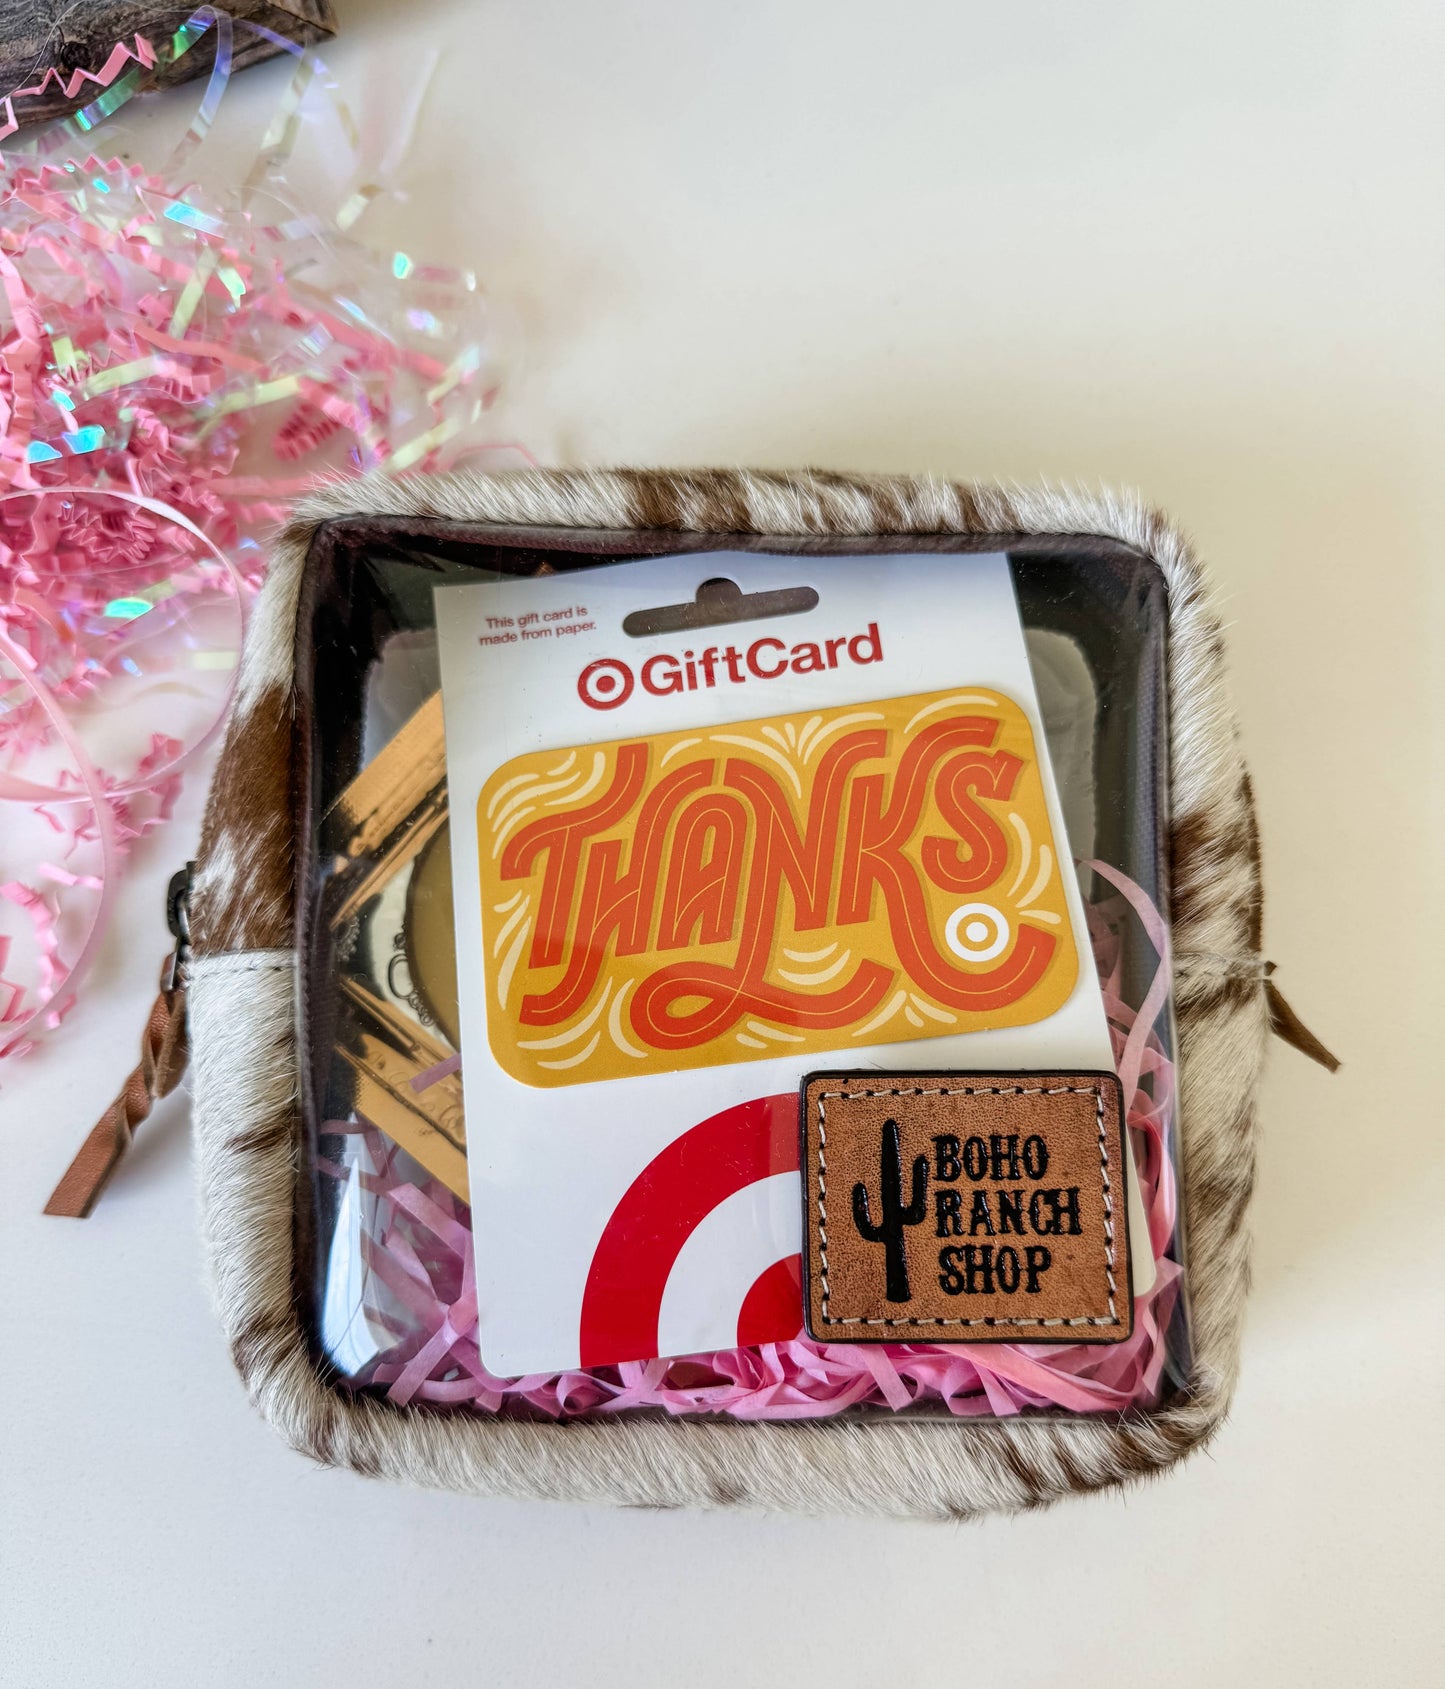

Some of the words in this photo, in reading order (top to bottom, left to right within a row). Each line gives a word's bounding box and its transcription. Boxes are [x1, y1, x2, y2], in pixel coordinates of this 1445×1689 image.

[479, 632, 518, 646] made
[521, 628, 553, 641] from
[555, 622, 597, 638] paper.
[485, 617, 515, 629] This
[517, 613, 540, 628] gift
[543, 608, 573, 621] card
[576, 606, 588, 617] is
[640, 622, 884, 696] GiftCard
[499, 715, 1057, 1051] THANKS
[931, 1133, 1050, 1182] BOHO
[934, 1187, 1083, 1238] RANCH
[937, 1244, 1052, 1296] SHOP
